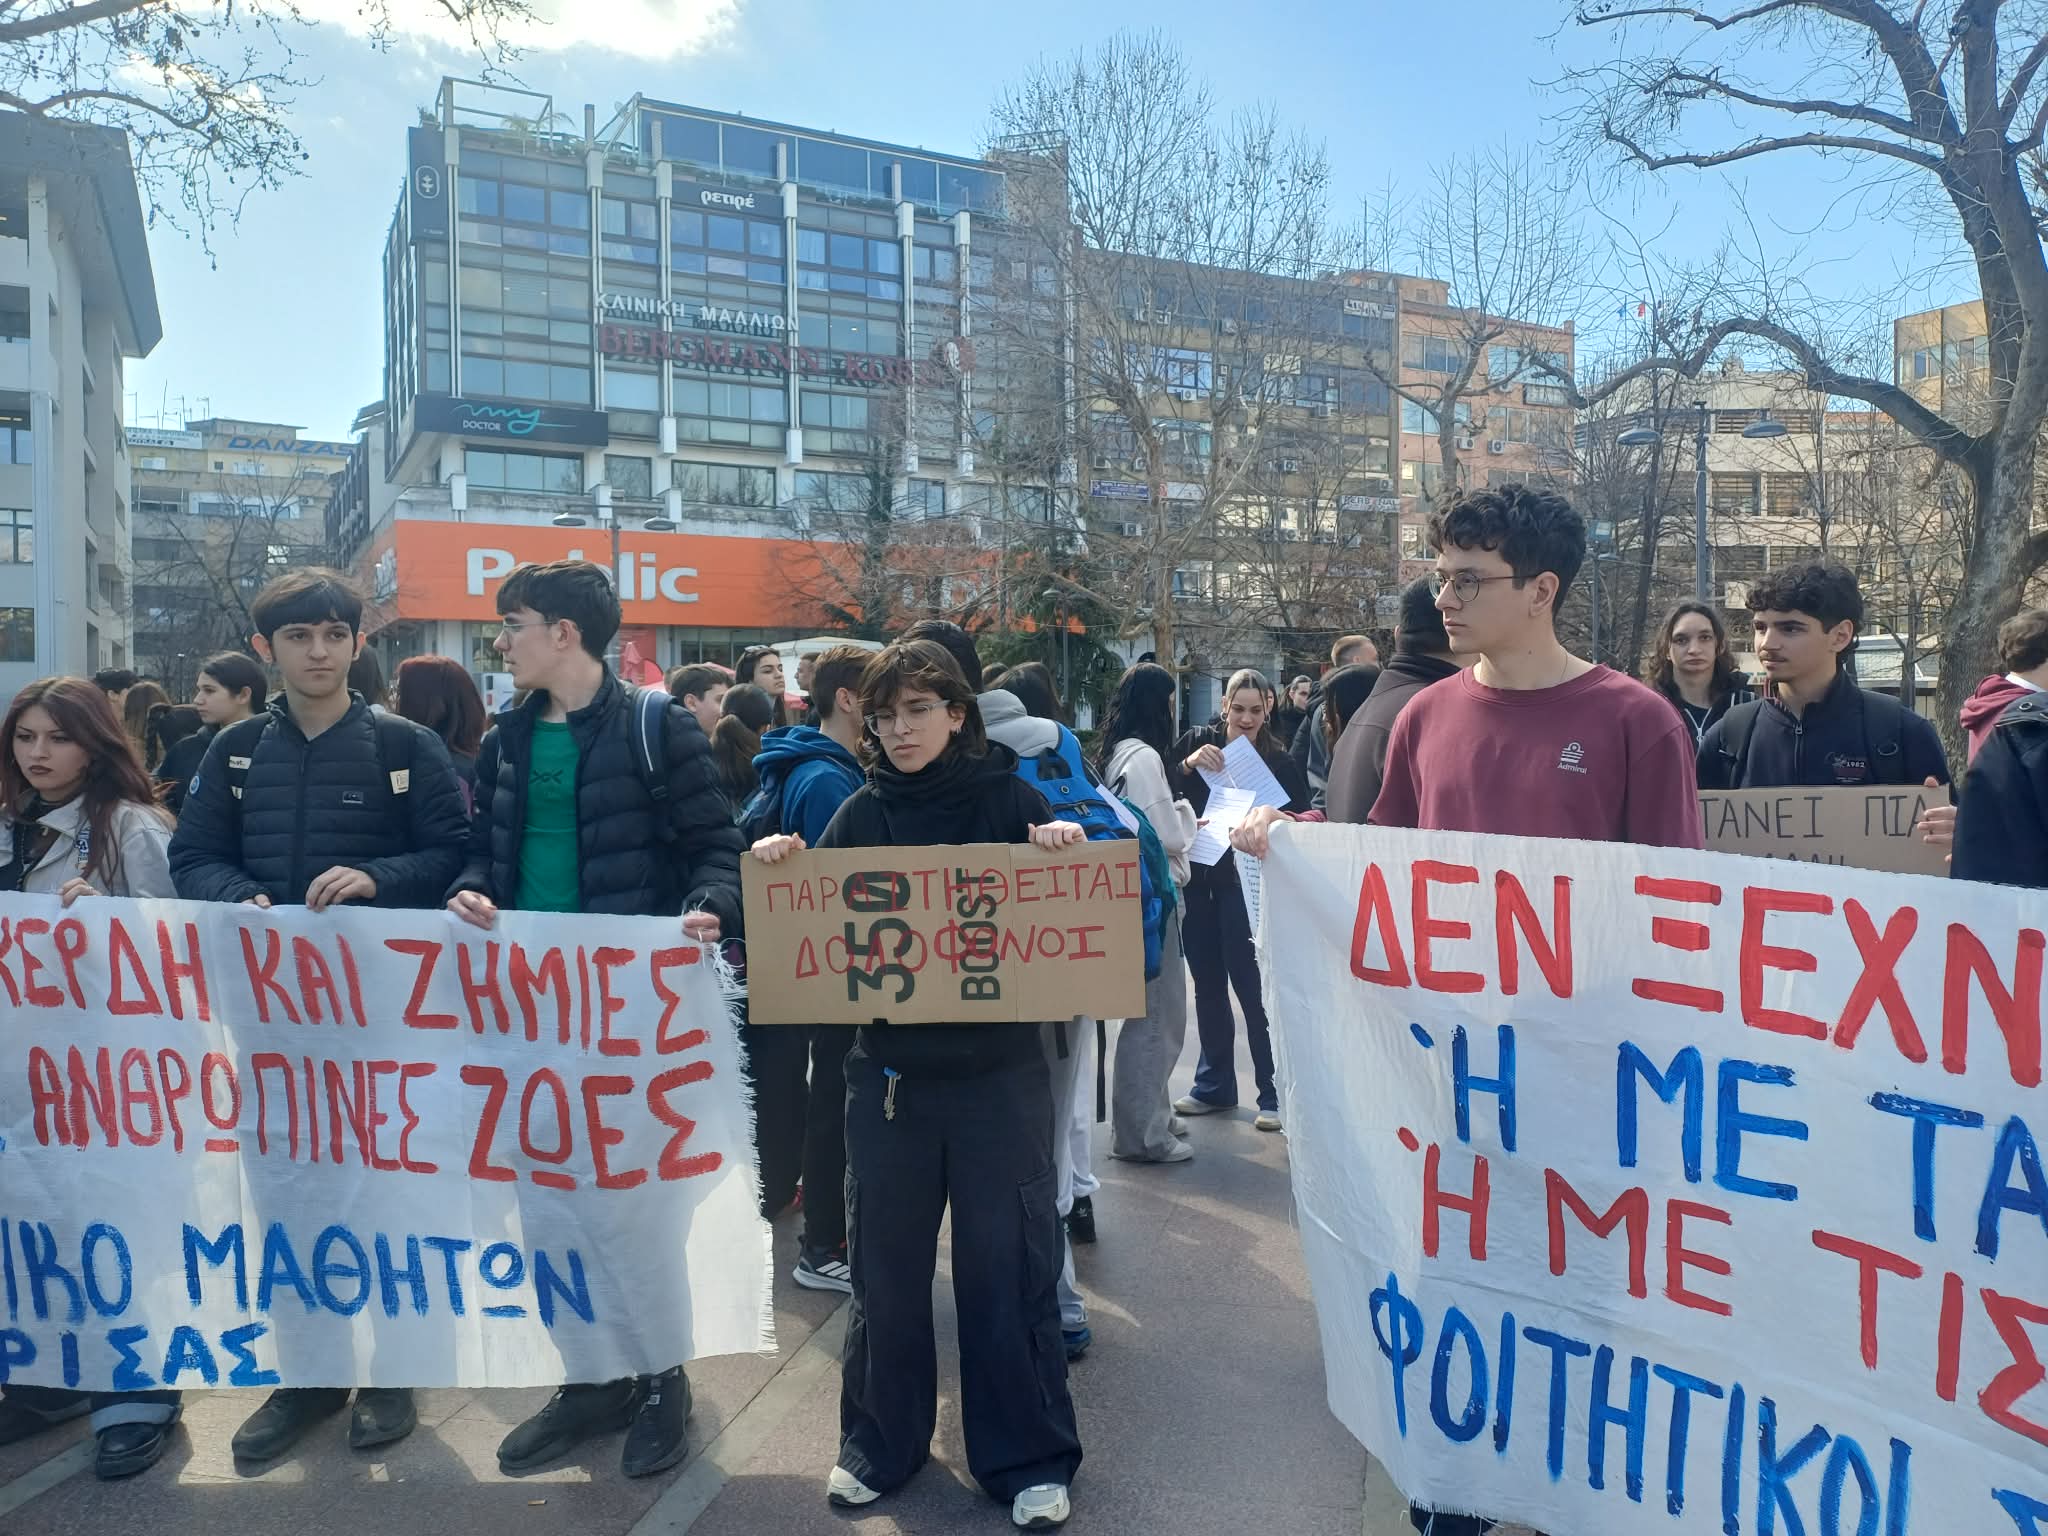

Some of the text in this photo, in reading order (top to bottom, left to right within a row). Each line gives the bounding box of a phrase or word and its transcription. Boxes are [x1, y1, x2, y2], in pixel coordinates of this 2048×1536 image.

[701, 191, 755, 210] ρετιρέ
[595, 292, 799, 332] ΚΛΙΝΙΚΗ ΜΑΛΛΙΩΝ
[601, 325, 823, 374] BERGMANN
[228, 437, 354, 456] DANZAS
[463, 419, 502, 431] DOCTOR
[466, 547, 700, 603] Plic
[1557, 762, 1588, 775] Admiral
[795, 918, 1106, 979] ΔΟΛΟΦΟΝΟΙ
[955, 867, 1001, 1001] BOOST
[239, 926, 367, 1028] ΚΑΙ
[384, 937, 711, 1057] ΖΗΜΙΕΣ
[1350, 860, 1574, 999] ΔΕΝ
[1631, 874, 2047, 1089] ΞΕΧΝ
[28, 1044, 723, 1191] ΑΝΘΡΩΠΙΝΕΣ ΖΩΕΣ
[1617, 1040, 1809, 1202] ΜΕ
[183, 1221, 595, 1328] ΜΑΘΗΤΩΝ
[1545, 1168, 1733, 1317] ΜΕ
[1812, 1229, 2048, 1446] ΤΙΣ
